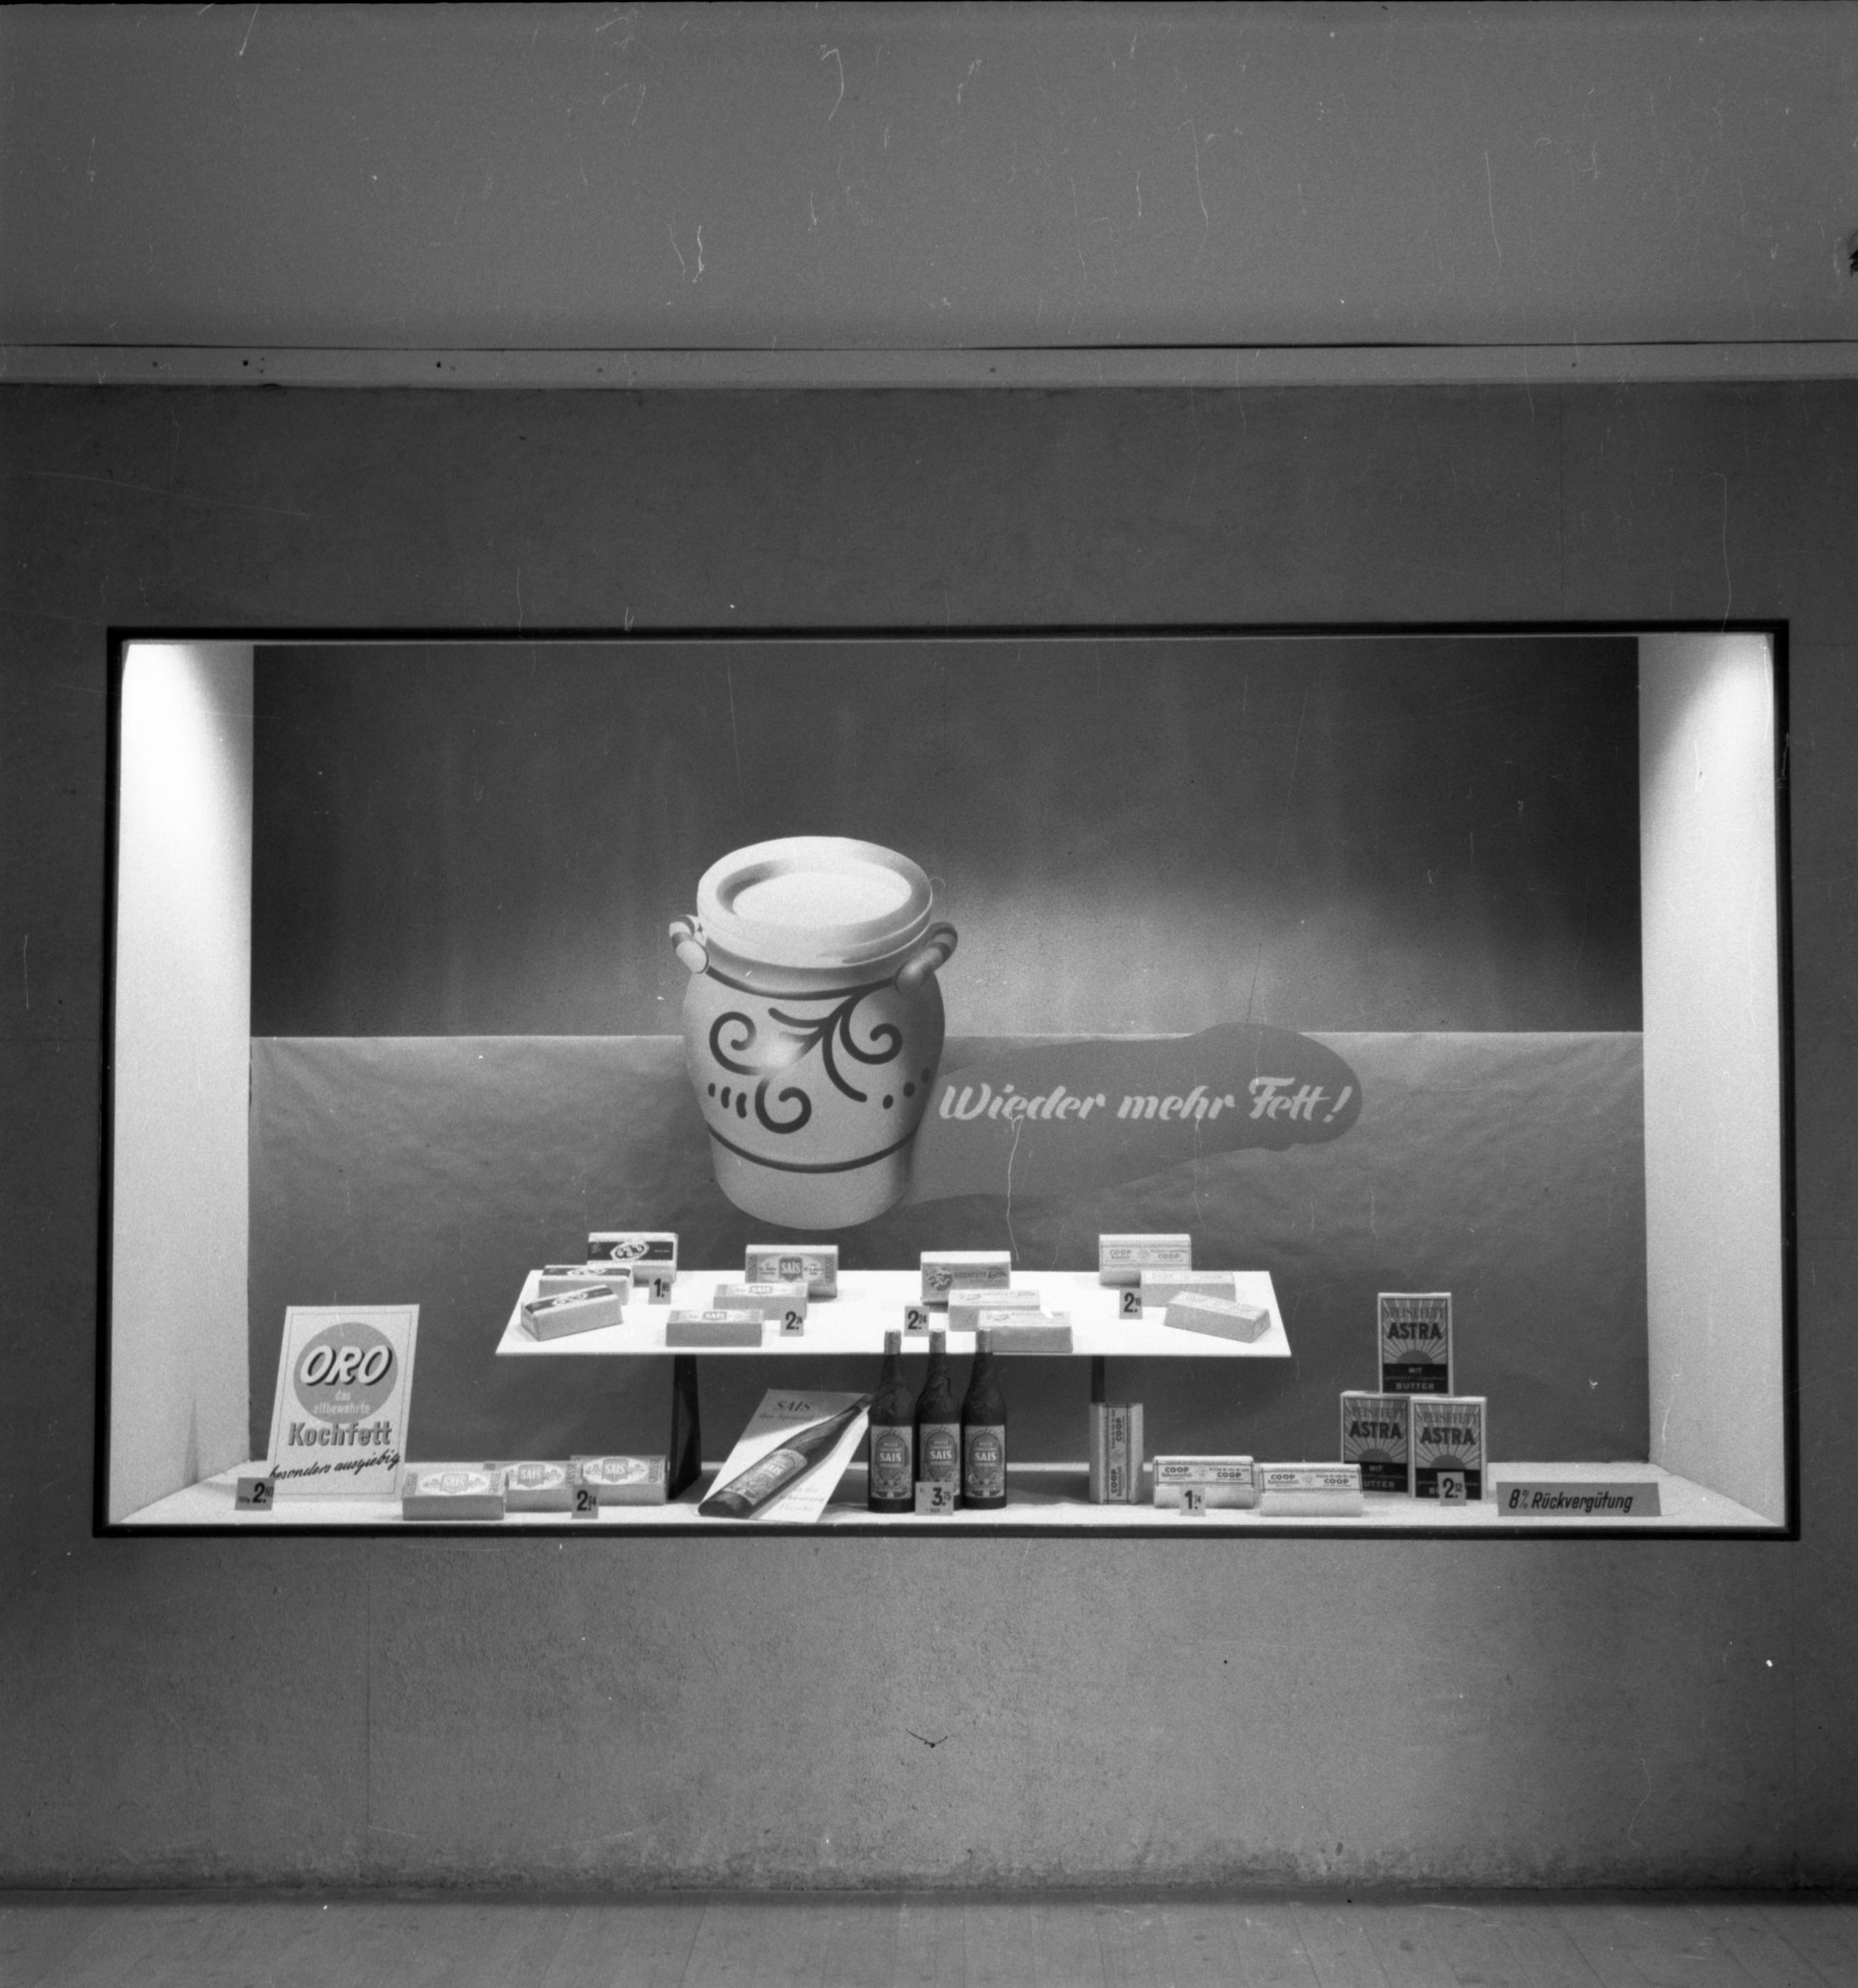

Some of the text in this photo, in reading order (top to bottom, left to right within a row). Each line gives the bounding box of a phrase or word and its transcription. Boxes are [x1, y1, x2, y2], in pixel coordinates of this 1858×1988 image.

[939, 1076, 1352, 1122] Wieder mehr Fett!
[780, 1261, 801, 1275] SAIS
[1387, 1322, 1443, 1340] ASTRA
[300, 1344, 392, 1386] ORO
[335, 1389, 351, 1402] das
[288, 1420, 392, 1446] Kochfett
[1349, 1421, 1402, 1440] ASTRA
[1420, 1427, 1476, 1445] ASTRA
[879, 1452, 902, 1463] SAIS
[930, 1450, 952, 1460] SAIS
[975, 1451, 997, 1462] SAIS
[268, 1448, 401, 1481] besonders ausgiebig
[604, 1463, 626, 1474] SAIS
[520, 1468, 542, 1479] SAIS
[1363, 1479, 1396, 1489] UTTER
[1508, 1489, 1634, 1513] 8% Rückvergütung
